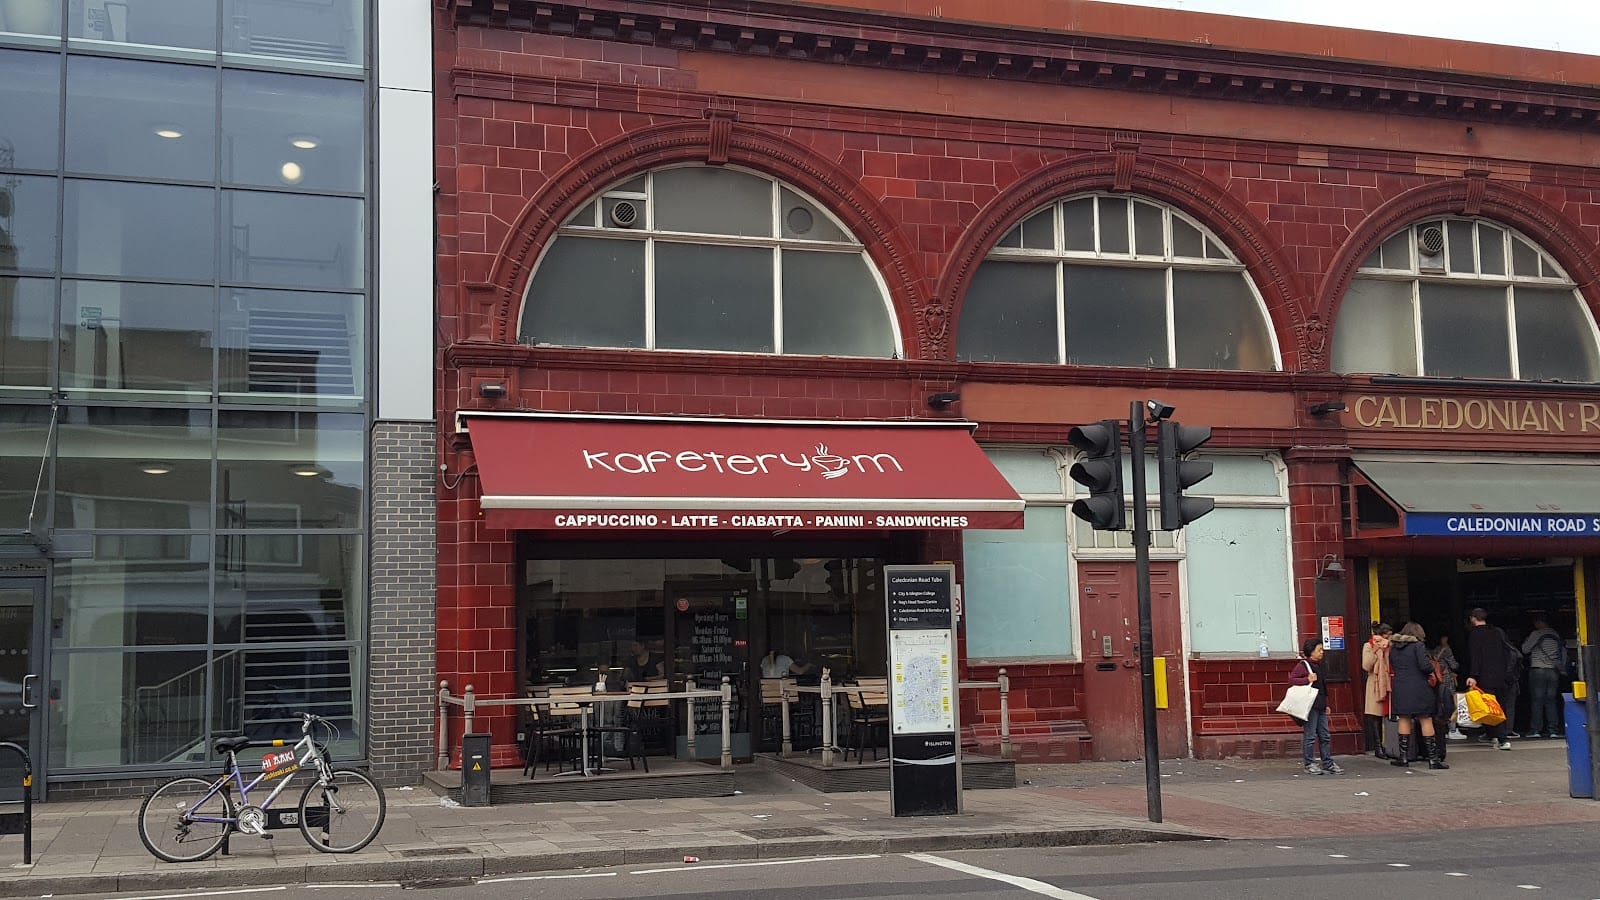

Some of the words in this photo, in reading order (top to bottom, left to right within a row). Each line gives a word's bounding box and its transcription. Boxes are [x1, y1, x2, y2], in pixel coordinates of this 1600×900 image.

[1354, 395, 1565, 432] CALEDONIAN
[554, 514, 659, 527] CAPPUCCINO
[671, 515, 719, 527] LATTE
[731, 515, 804, 528] CIABATTA
[815, 515, 864, 528] PANINI
[876, 515, 969, 528] SANDWICHES
[1446, 517, 1542, 532] CALEDONIAN
[1547, 518, 1586, 532] ROAD
